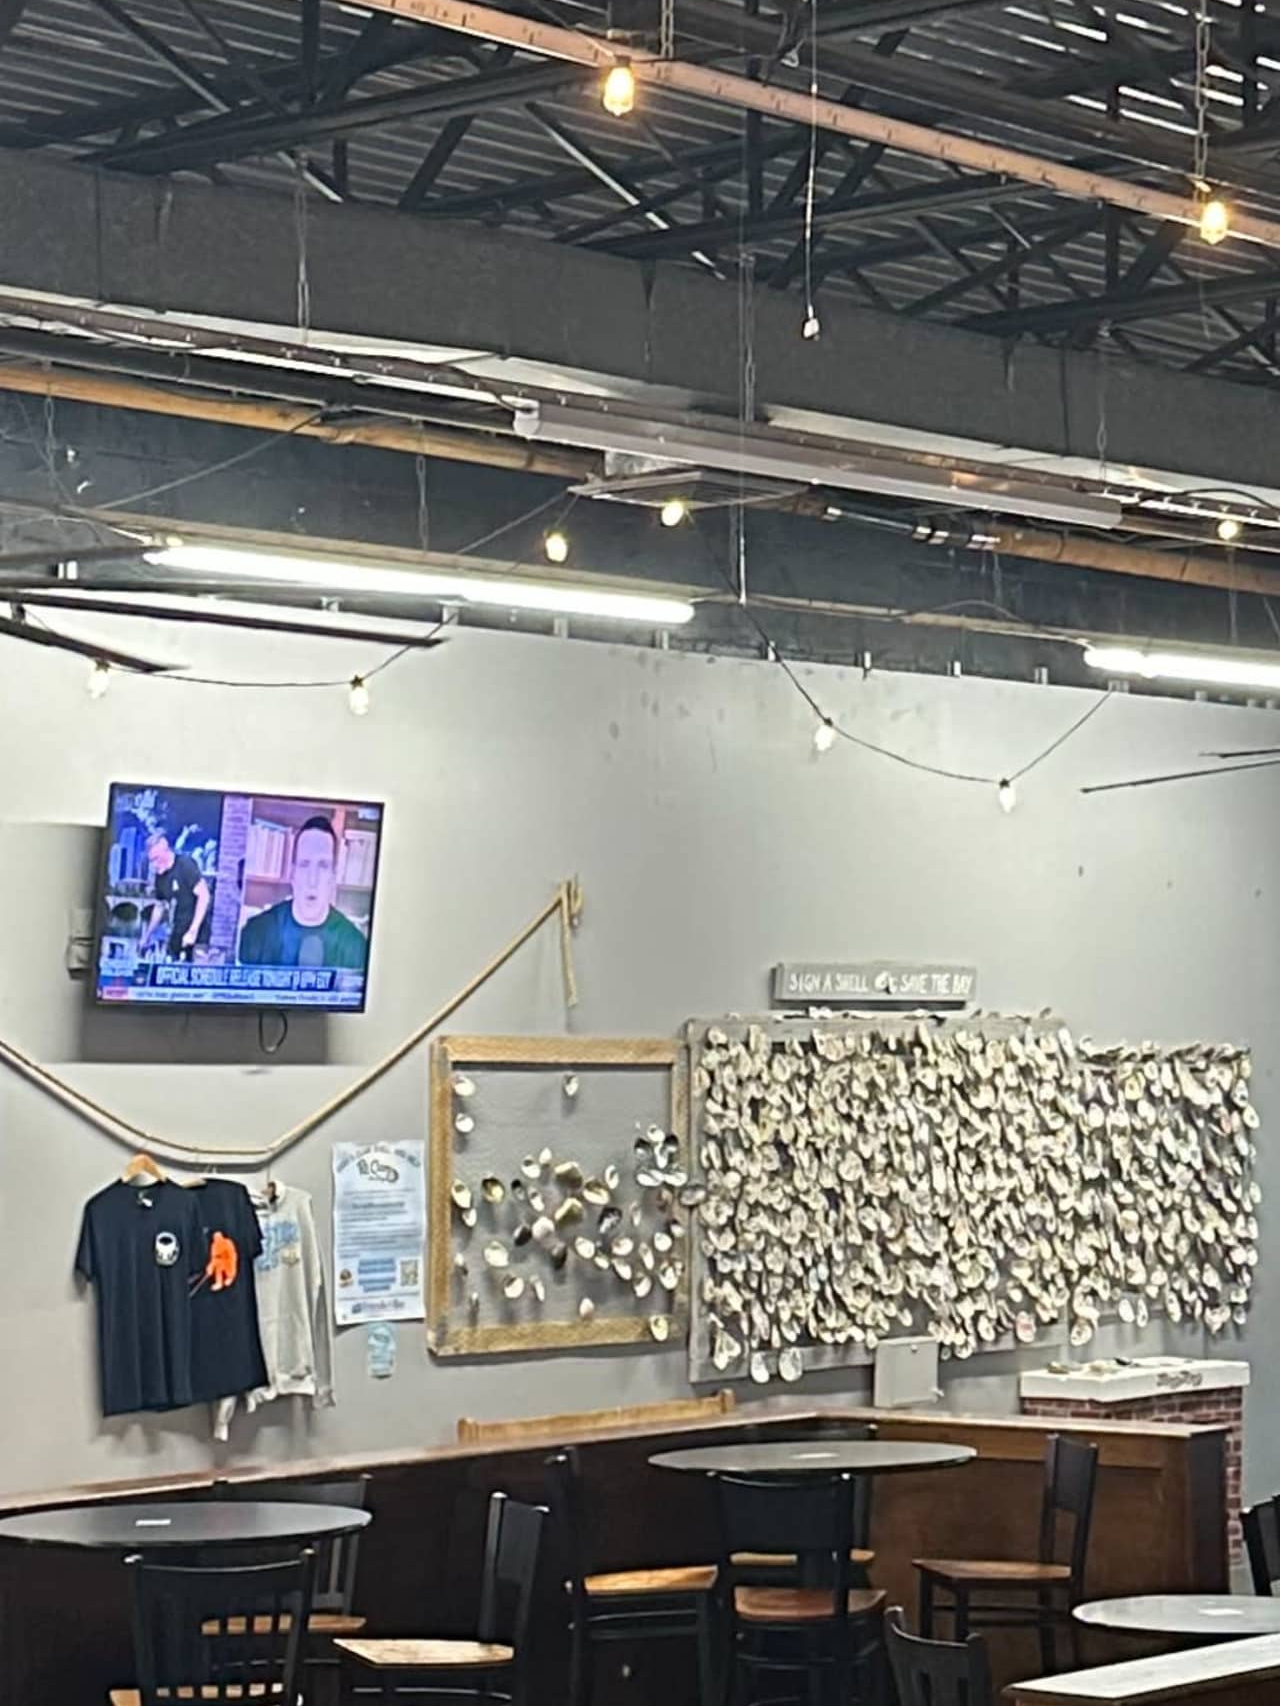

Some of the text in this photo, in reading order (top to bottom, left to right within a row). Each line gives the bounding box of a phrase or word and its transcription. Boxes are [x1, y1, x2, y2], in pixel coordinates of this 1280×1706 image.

[156, 966, 188, 985] OFFICIAL
[789, 973, 819, 992] SIGN
[821, 973, 831, 992] A
[835, 972, 869, 992] SHELL
[900, 973, 928, 993] SAVE
[930, 973, 950, 993] THE
[951, 973, 974, 994] BAY
